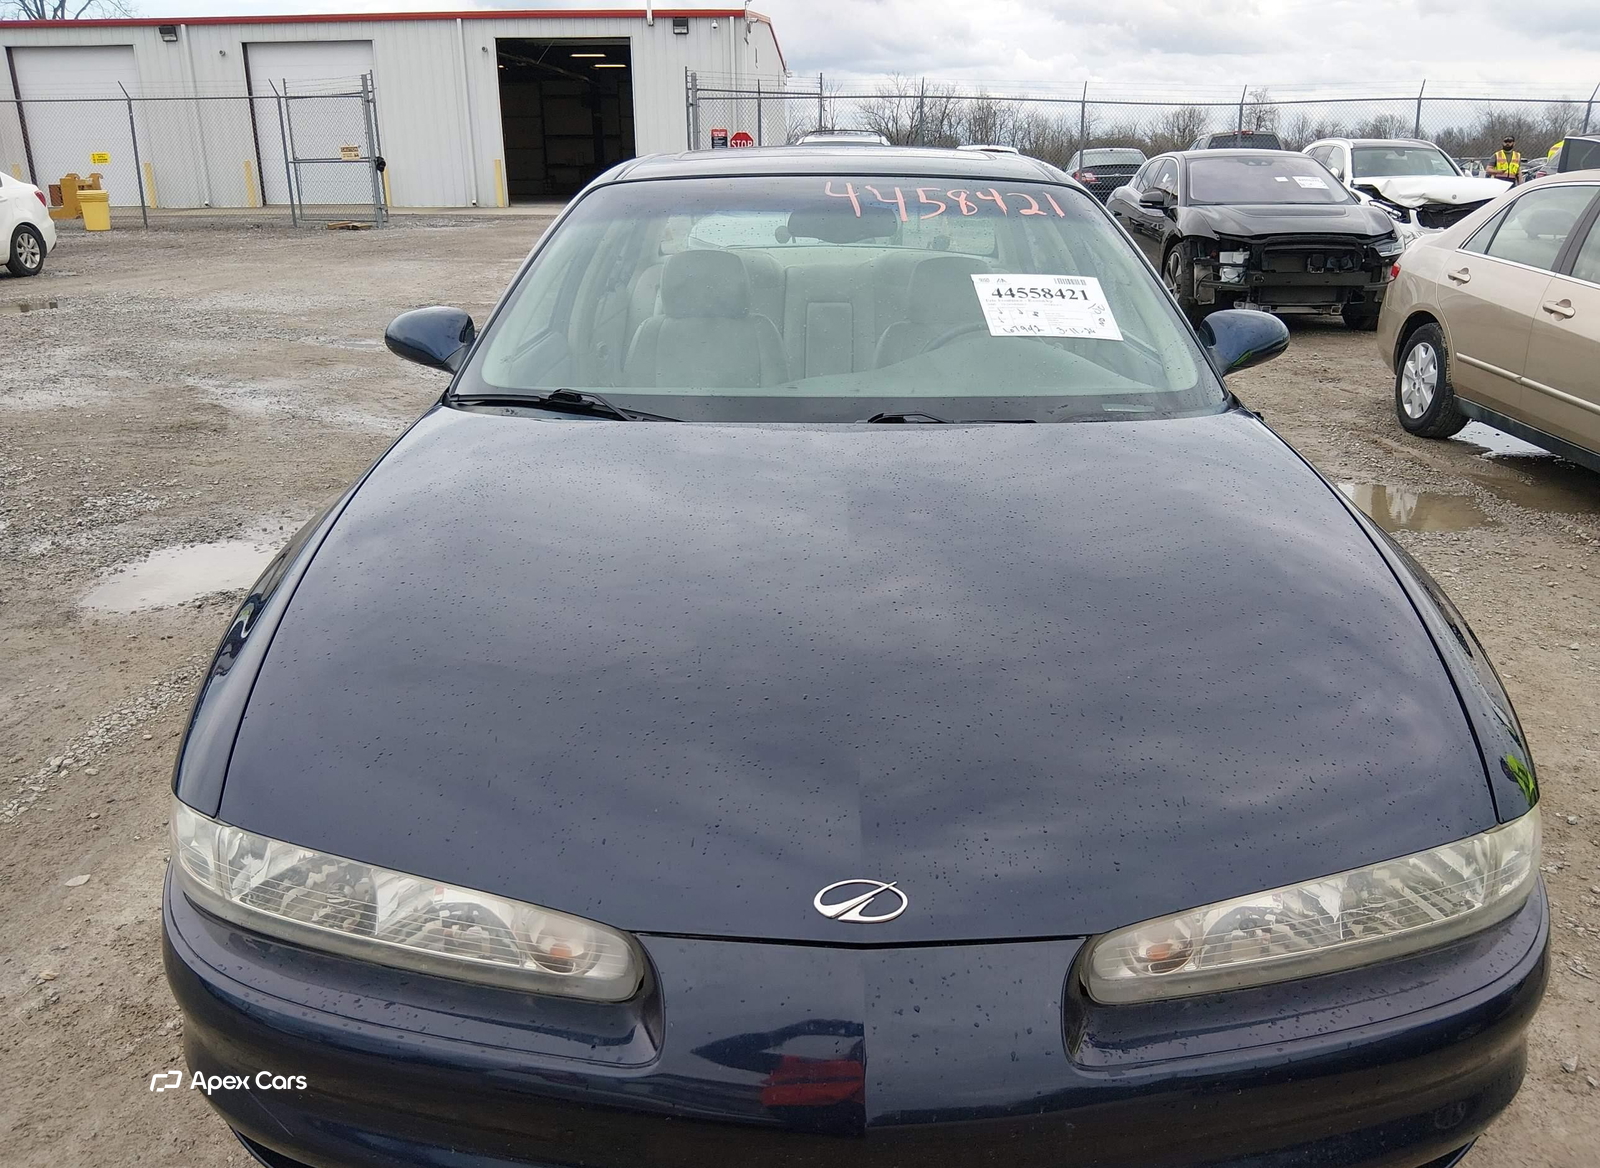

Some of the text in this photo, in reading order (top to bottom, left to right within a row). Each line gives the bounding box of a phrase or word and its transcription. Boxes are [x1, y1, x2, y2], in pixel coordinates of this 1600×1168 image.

[731, 140, 753, 148] STOP
[824, 181, 1065, 222] 4458421
[991, 287, 1090, 301] 44558421
